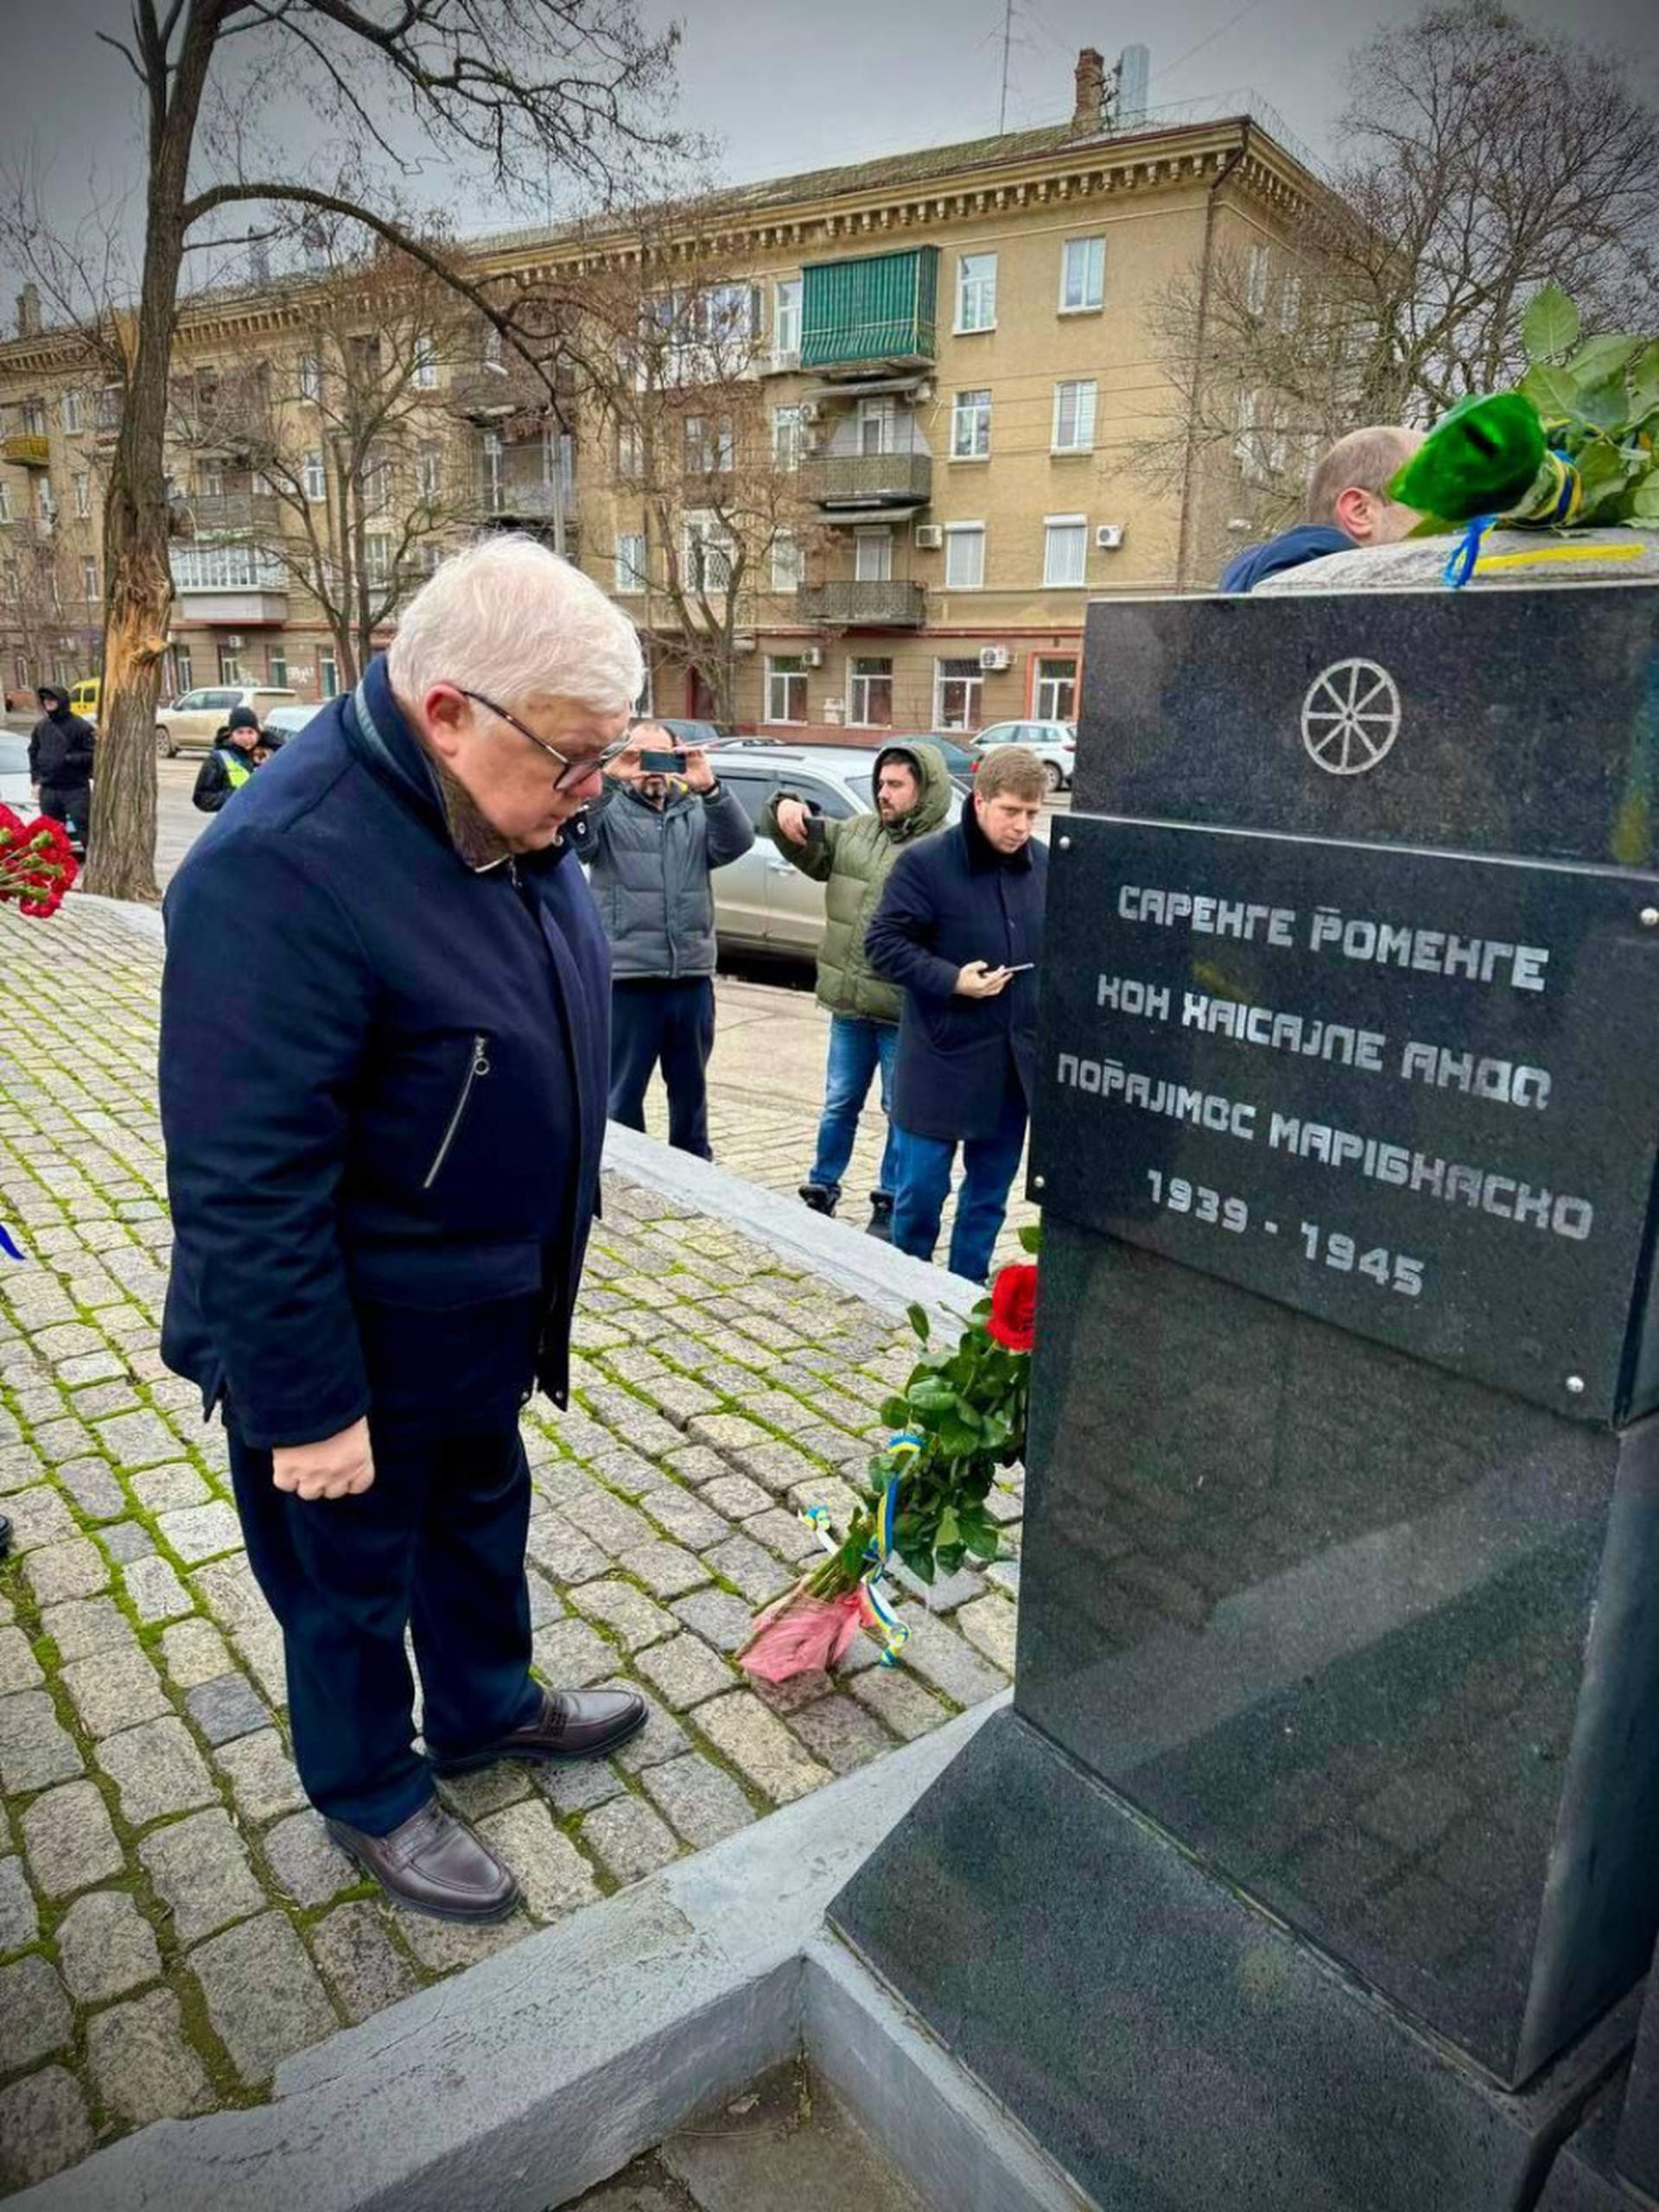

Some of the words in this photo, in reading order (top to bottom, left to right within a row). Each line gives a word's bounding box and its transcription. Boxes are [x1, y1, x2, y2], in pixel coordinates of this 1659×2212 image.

[1118, 884, 1296, 947] САРЕНГЕ
[1147, 1168, 1249, 1234] 1939
[1300, 1220, 1426, 1297] 1945
